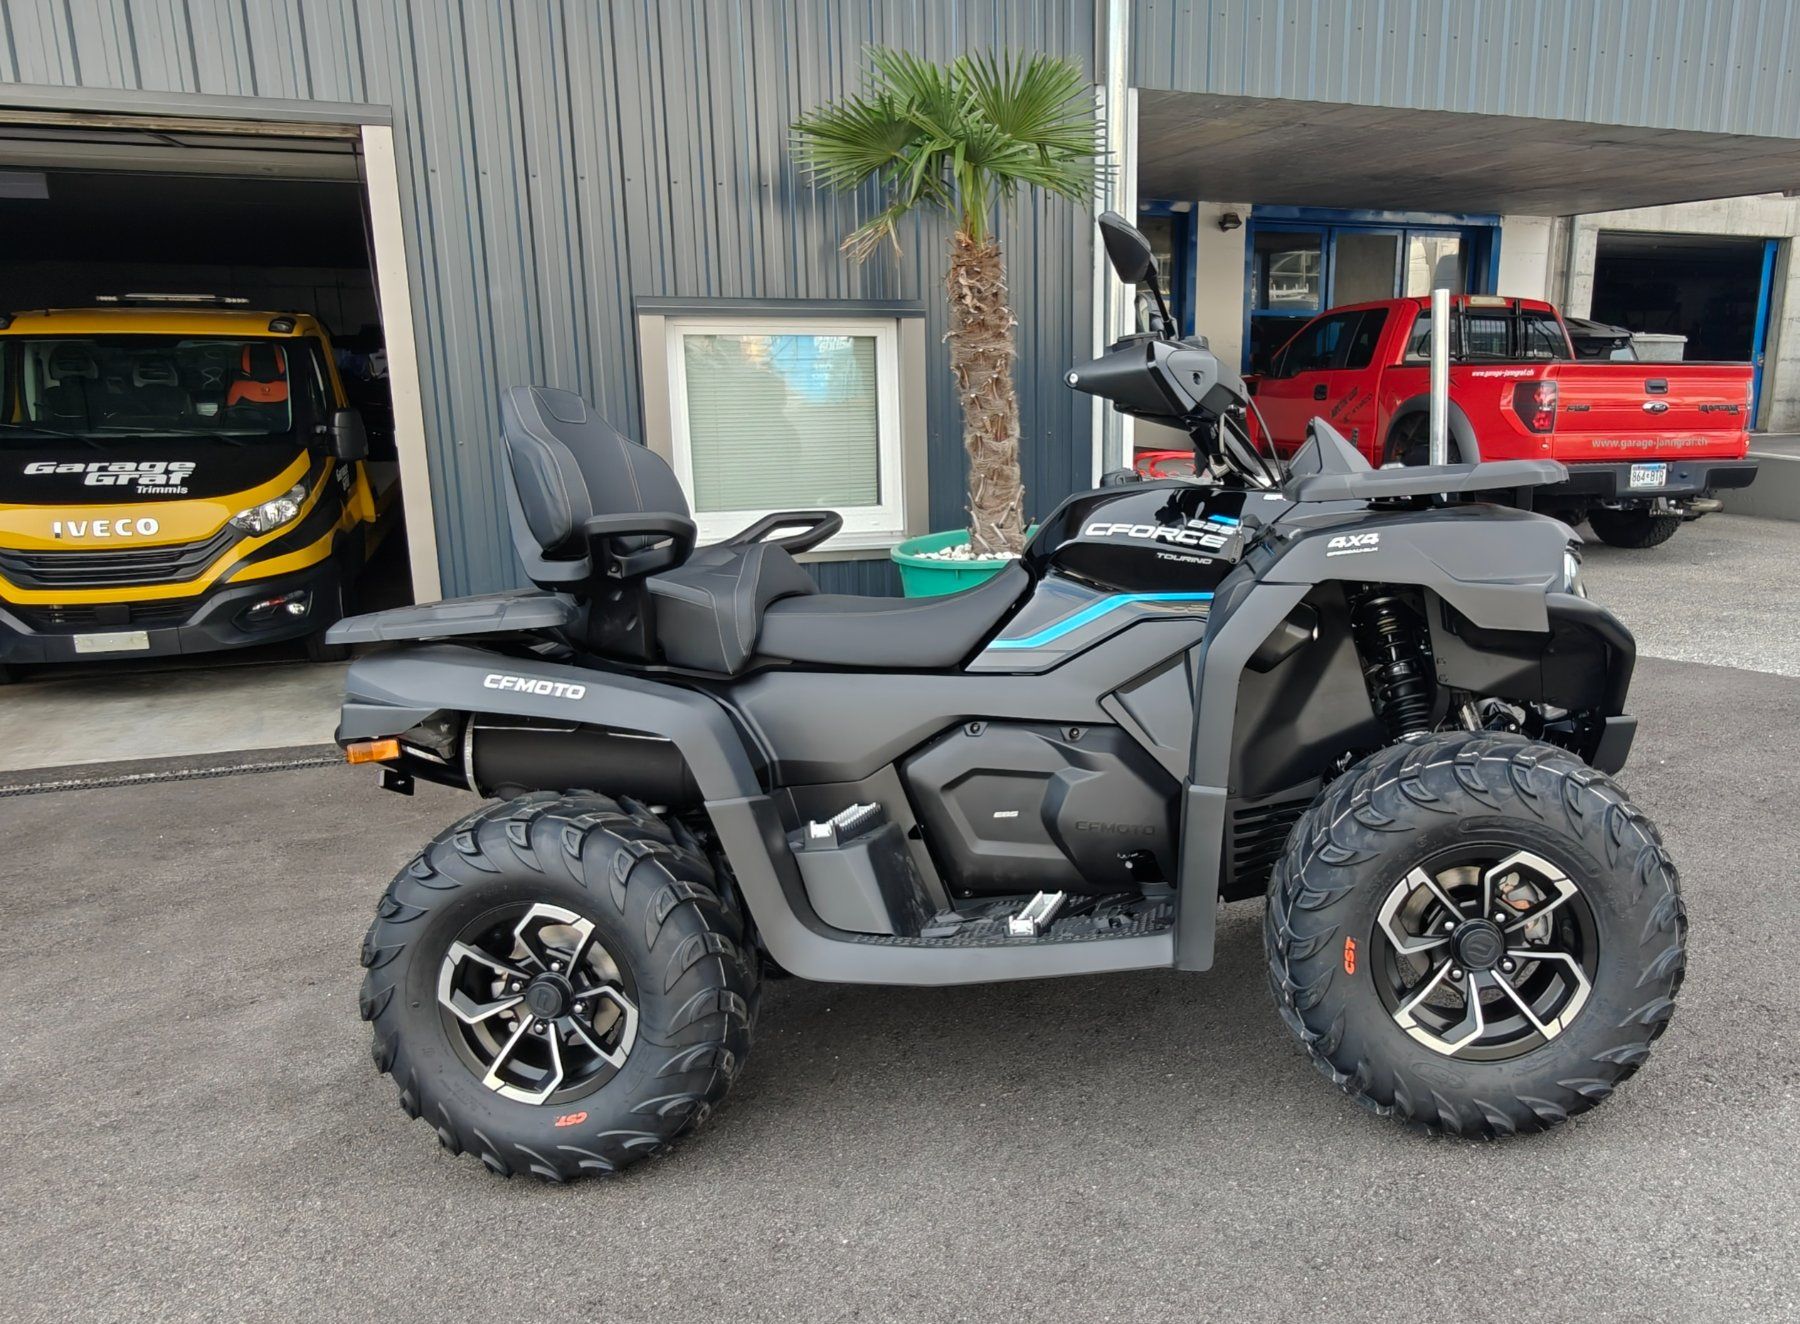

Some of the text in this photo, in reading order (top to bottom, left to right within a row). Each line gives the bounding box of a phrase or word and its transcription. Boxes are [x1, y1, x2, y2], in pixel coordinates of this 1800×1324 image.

[23, 461, 196, 475] Garage
[83, 471, 193, 486] Graf
[136, 485, 188, 494] Trimmis
[53, 518, 159, 539] IVECO
[1187, 519, 1237, 535] 625
[1085, 523, 1228, 548] CFORCE
[1156, 552, 1213, 565] TOURING
[483, 674, 586, 700] CFMOTO
[1074, 820, 1156, 836] CFMOTO
[1344, 936, 1356, 975] CST
[555, 1111, 588, 1127] CST
